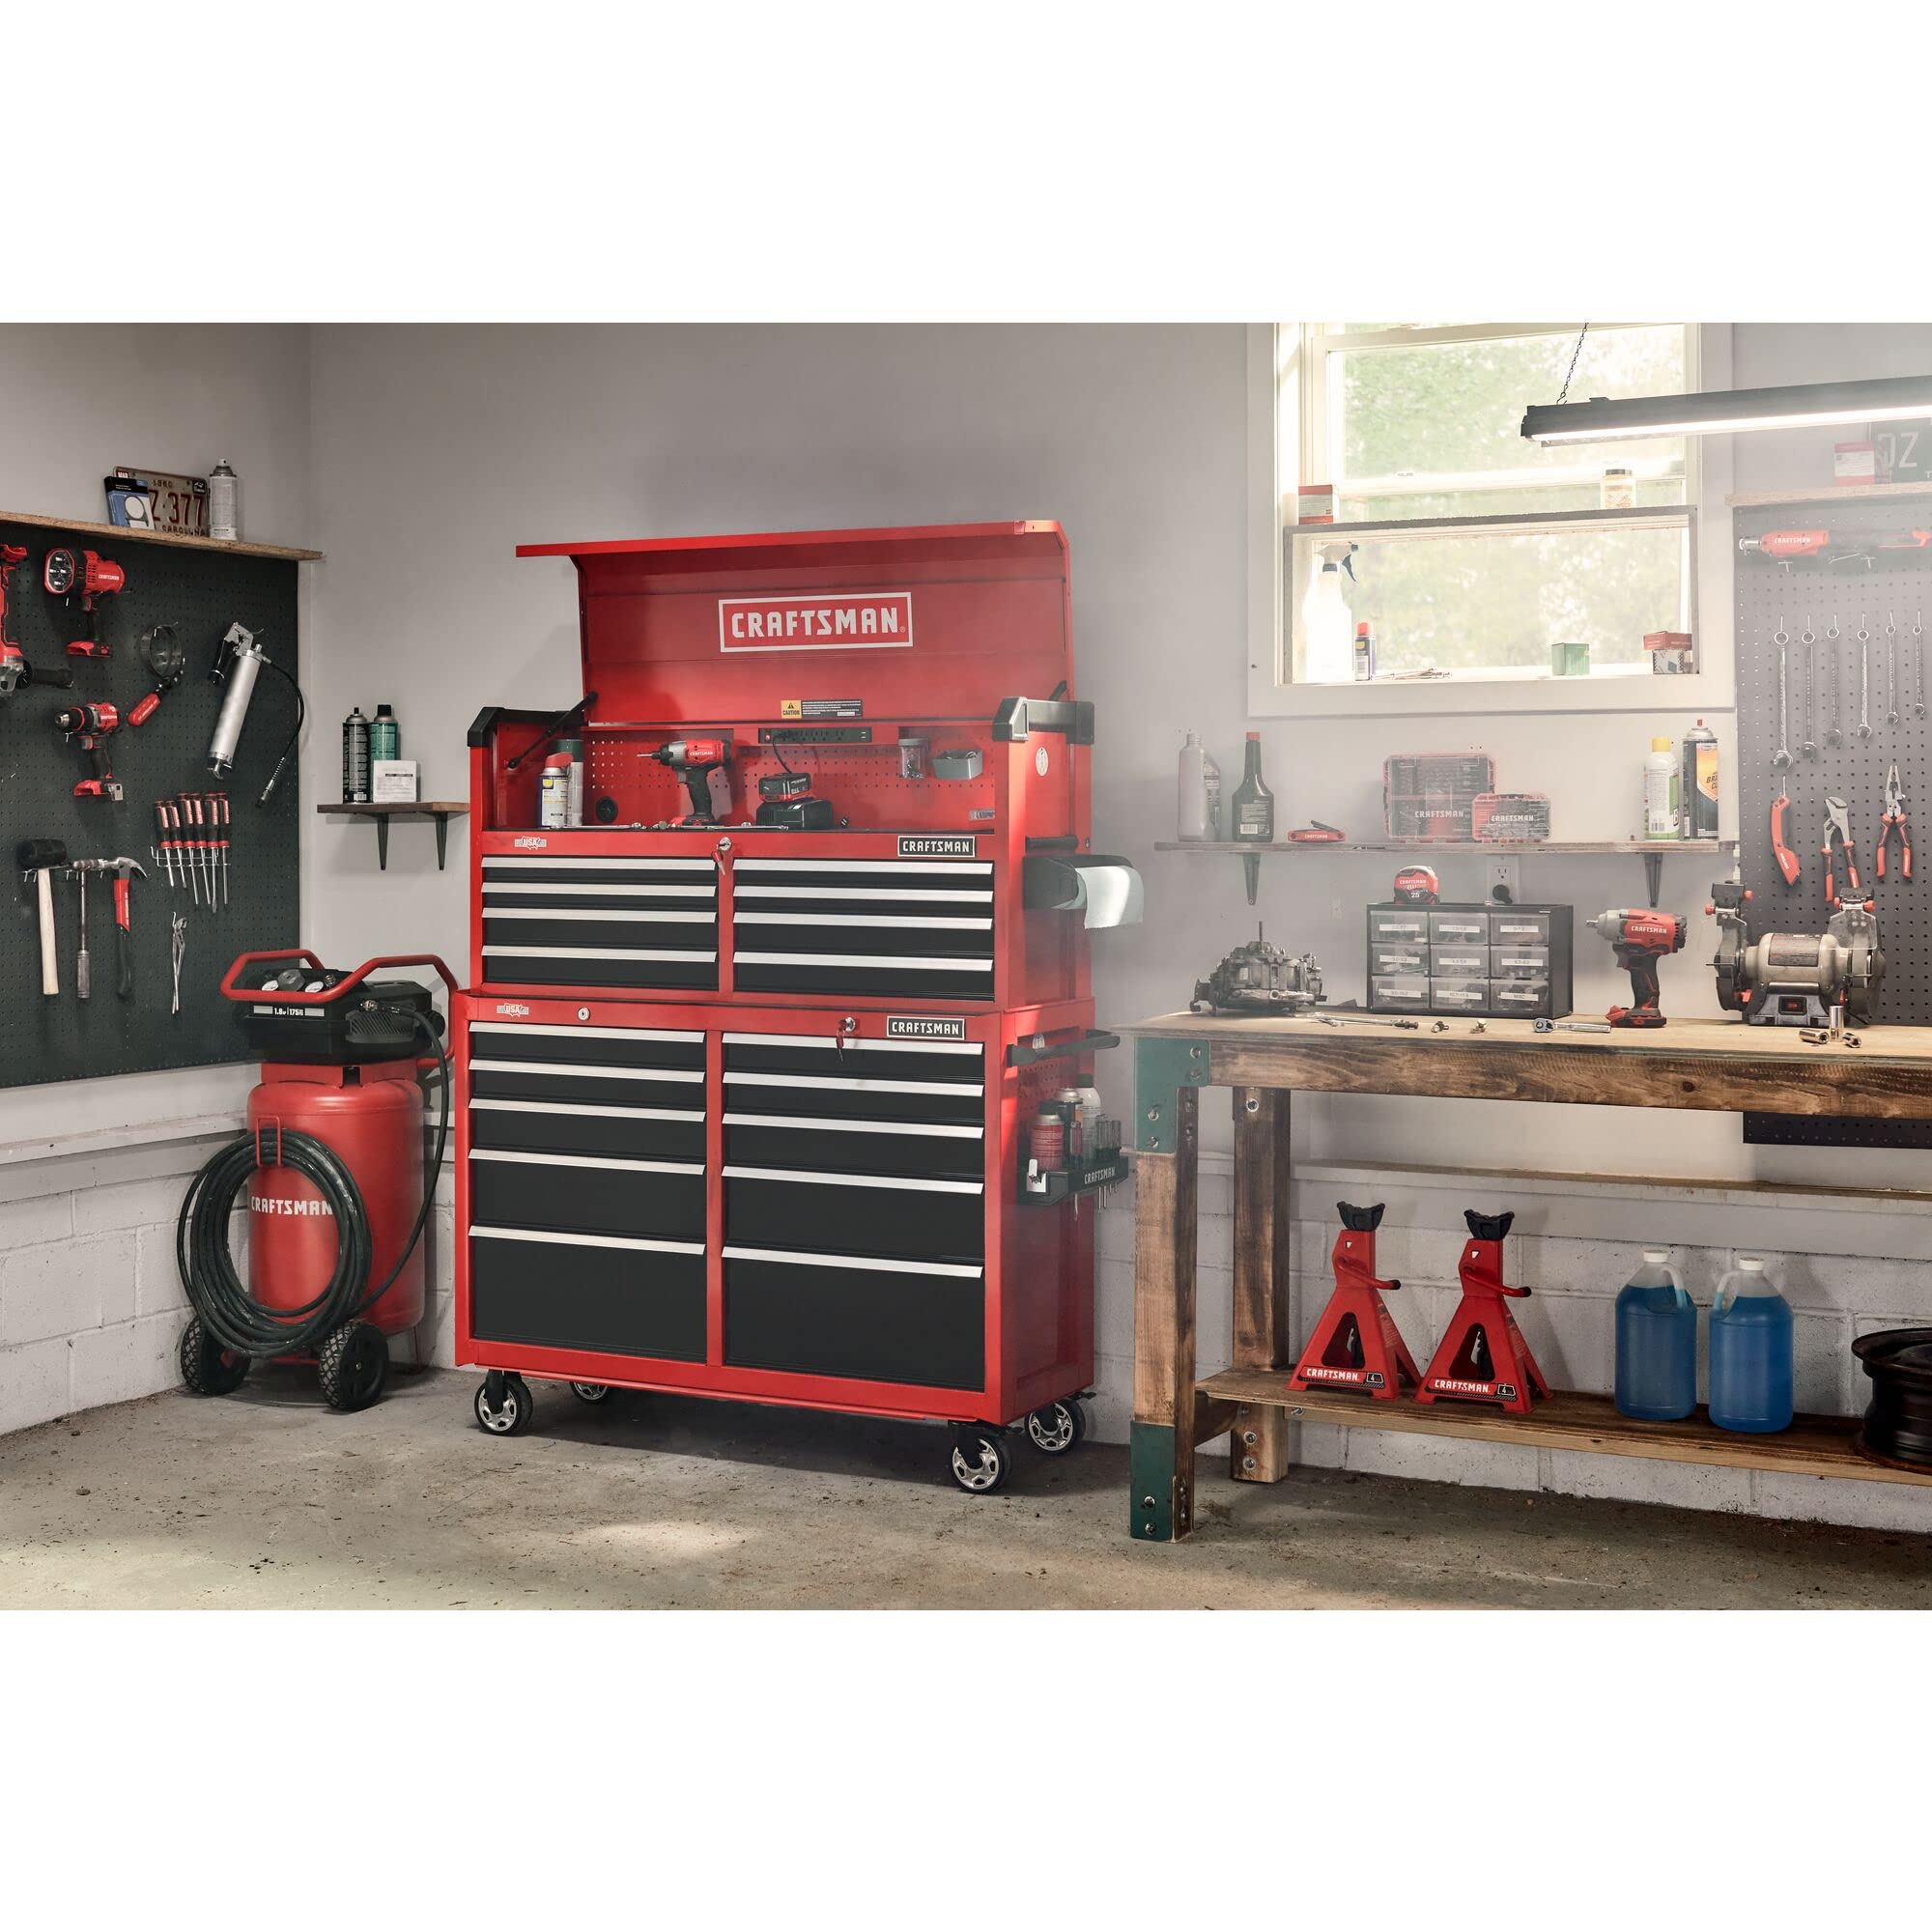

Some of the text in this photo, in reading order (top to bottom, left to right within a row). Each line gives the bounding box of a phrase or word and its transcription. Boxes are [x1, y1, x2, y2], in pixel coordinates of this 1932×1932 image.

[731, 607, 898, 639] CRAFTSMAN
[902, 839, 970, 853] CRAFTSMAN
[1631, 924, 1667, 934] CRAFTSMAN
[893, 1021, 960, 1035] CRAFTSMAN
[1084, 1167, 1117, 1185] CRAFTSMAN
[251, 1196, 332, 1215] CRAFTSMAN
[1306, 1368, 1359, 1381] CRAFTSMAN
[1435, 1379, 1490, 1393] CRAFTSMAN
